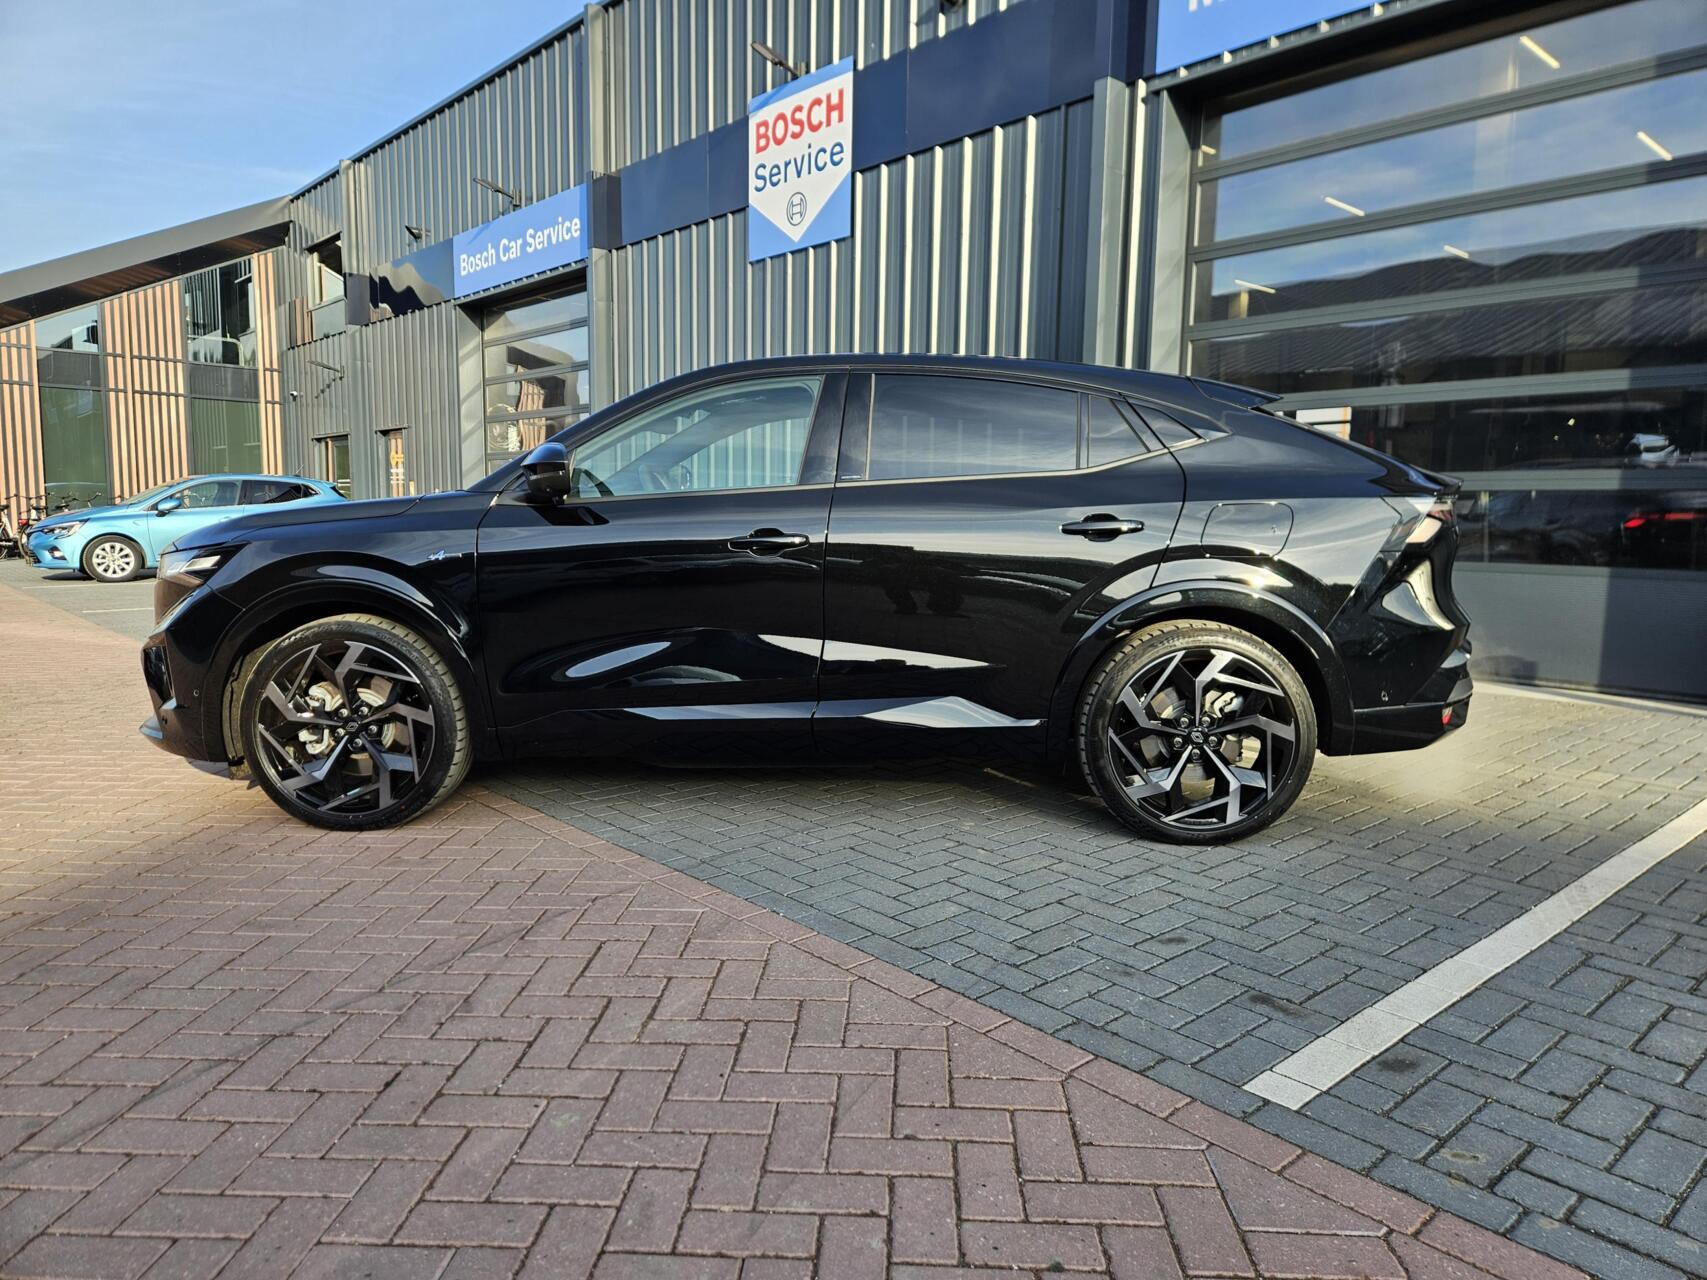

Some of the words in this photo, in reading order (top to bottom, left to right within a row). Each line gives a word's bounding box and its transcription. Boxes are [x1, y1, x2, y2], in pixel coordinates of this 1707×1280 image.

[755, 87, 844, 155] BOSCH
[754, 141, 845, 193] Service
[460, 243, 496, 276] Bosch
[500, 237, 523, 262] Car
[526, 216, 581, 253] Service
